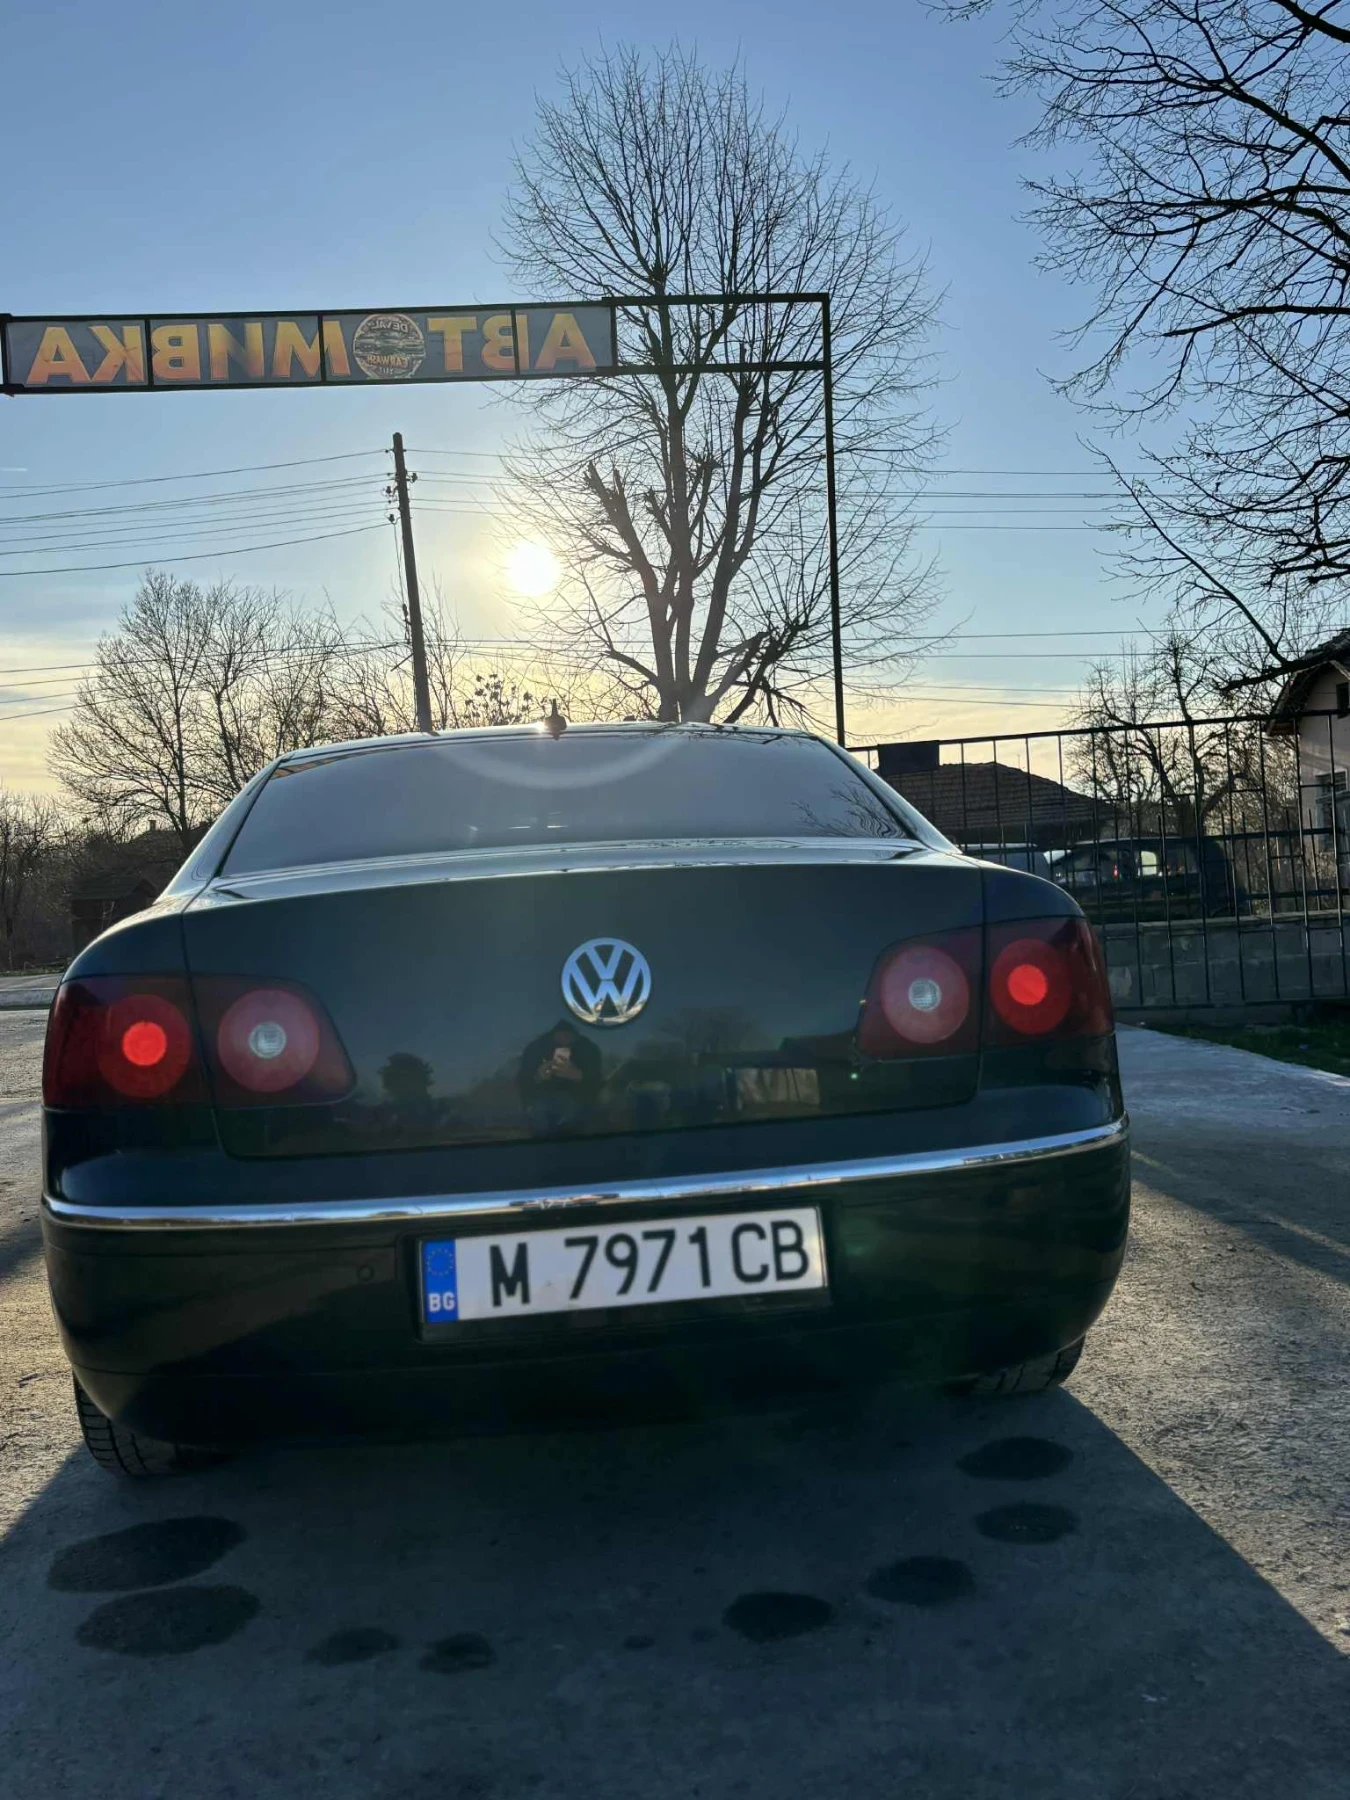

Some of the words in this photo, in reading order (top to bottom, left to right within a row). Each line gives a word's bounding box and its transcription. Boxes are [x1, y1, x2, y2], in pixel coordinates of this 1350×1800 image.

[561, 937, 651, 1024] VW
[429, 1292, 455, 1312] BG
[489, 1242, 531, 1307] M
[564, 1225, 712, 1300] 7971
[731, 1219, 810, 1284] CB
